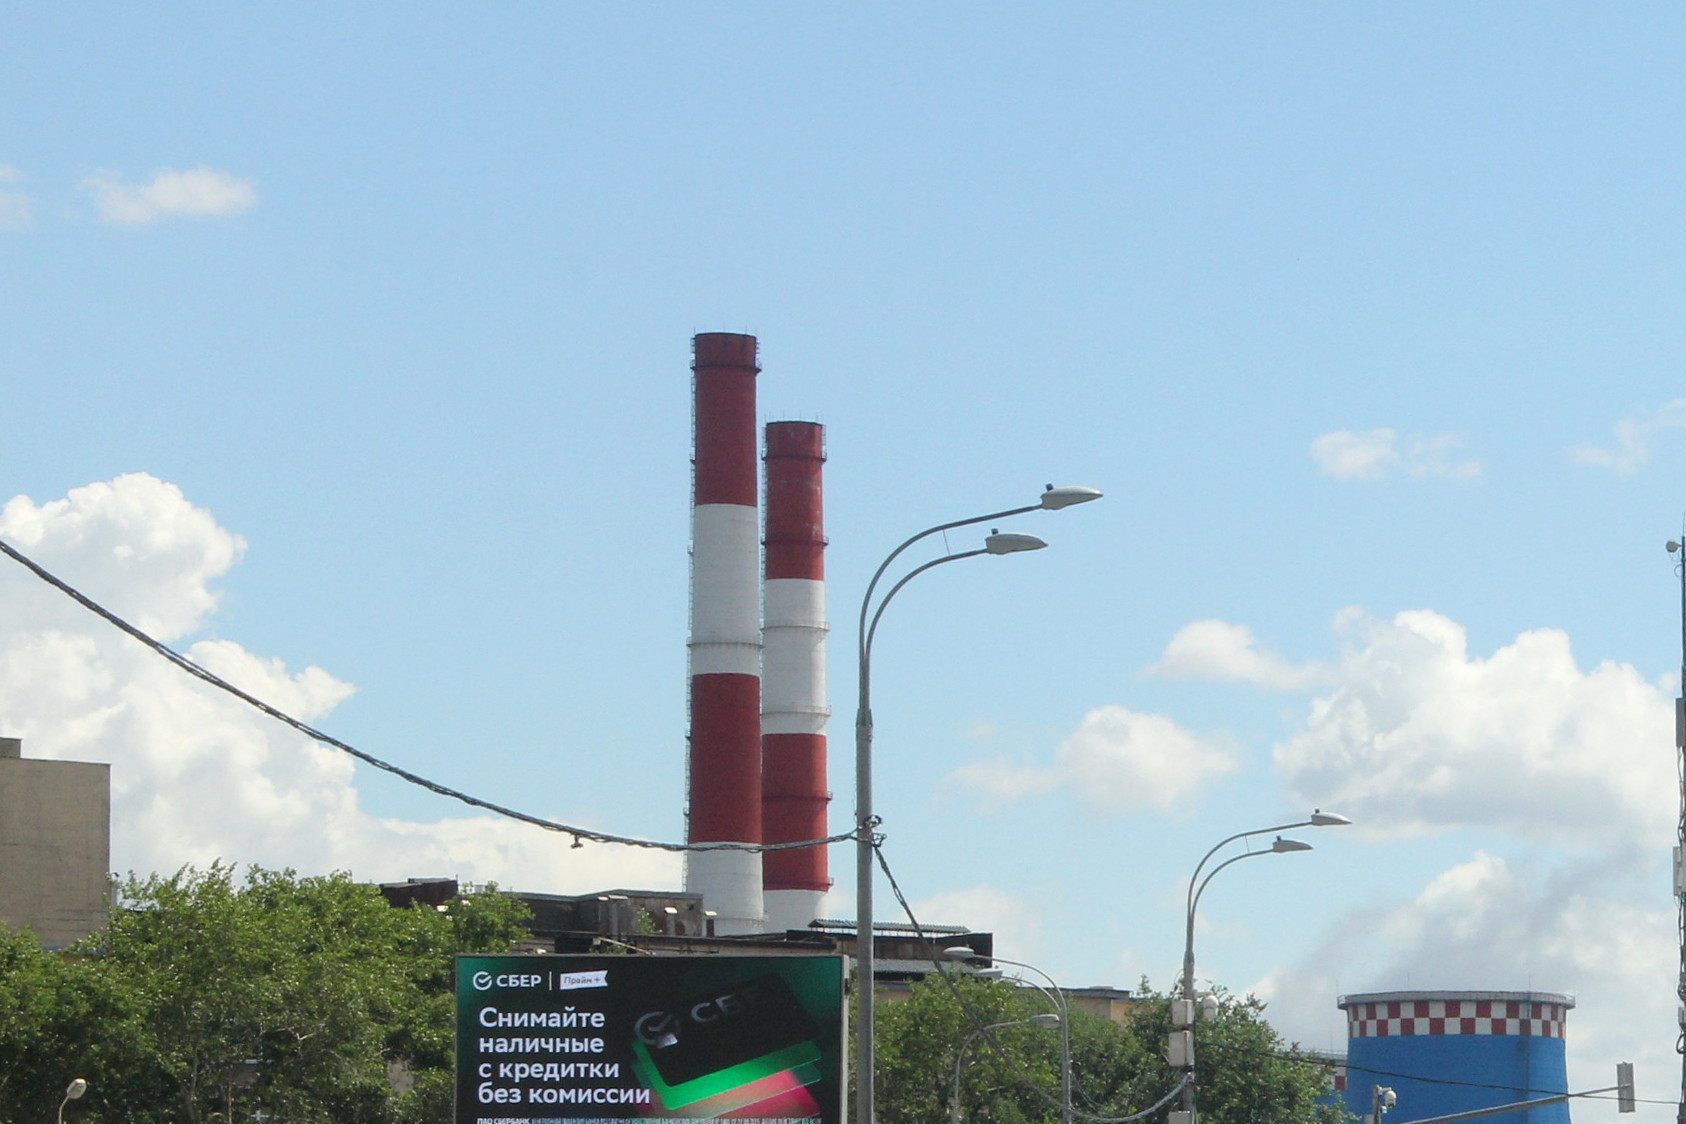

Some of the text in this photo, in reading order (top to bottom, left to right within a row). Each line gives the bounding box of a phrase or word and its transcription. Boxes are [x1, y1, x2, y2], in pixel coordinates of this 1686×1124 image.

[496, 974, 542, 988] СБЕР
[479, 1006, 606, 1028] Снимайте
[479, 1037, 605, 1053] наличные
[478, 1063, 620, 1082] с кредитки
[478, 1081, 650, 1104] без комиссии
